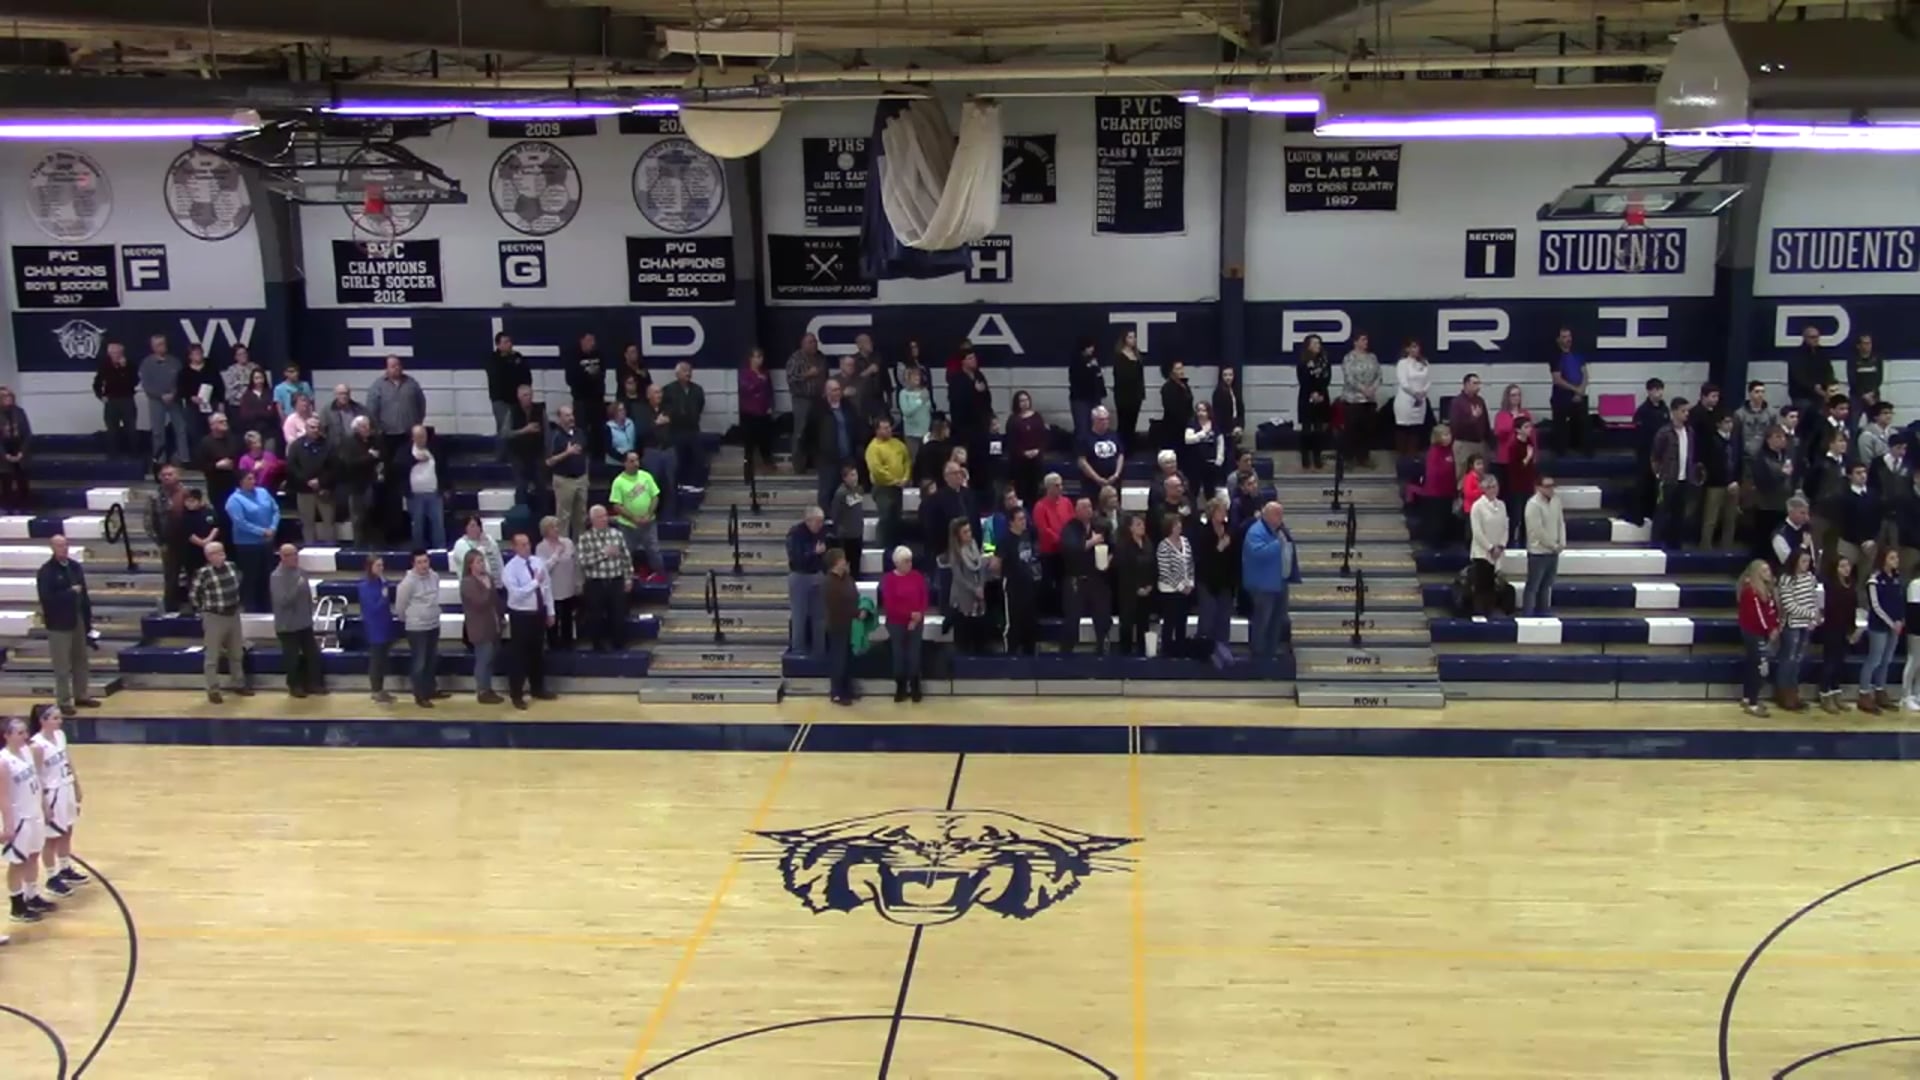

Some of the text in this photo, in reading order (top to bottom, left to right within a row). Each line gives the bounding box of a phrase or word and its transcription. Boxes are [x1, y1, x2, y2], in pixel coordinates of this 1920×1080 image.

[1121, 98, 1162, 115] PVC
[1100, 116, 1182, 130] CHAMPIONS
[525, 123, 560, 136] 2009
[1122, 132, 1160, 145] GOLF
[828, 139, 865, 152] PIHS
[1305, 166, 1378, 178] CLASS A
[1288, 181, 1394, 192] BOYS CROSS COUNTRY
[1469, 233, 1514, 241] SECTION
[124, 248, 165, 256] SECTION
[501, 244, 543, 252] SECTION
[665, 243, 696, 253] PVC
[1545, 232, 1680, 272] STUDENTS
[1775, 230, 1915, 270] STUDENTS
[48, 251, 79, 261] PVC
[1485, 245, 1496, 274] I
[349, 261, 427, 274] CHAMPIONS
[639, 258, 725, 269] CHAMPIONS
[971, 251, 1006, 279] H
[24, 266, 107, 277] CHAMPIONS
[130, 260, 160, 287] F
[505, 255, 541, 284] G
[341, 276, 436, 288] GIRLS SOCCER
[638, 273, 726, 283] GIRLS SOCCER
[24, 281, 108, 291] BOYS SOCCER
[373, 290, 405, 302] 2012
[667, 288, 699, 297] 2014
[721, 584, 743, 592] ROW
[1346, 656, 1372, 664] ROW
[691, 693, 717, 701] ROW
[1354, 697, 1381, 705] ROW
